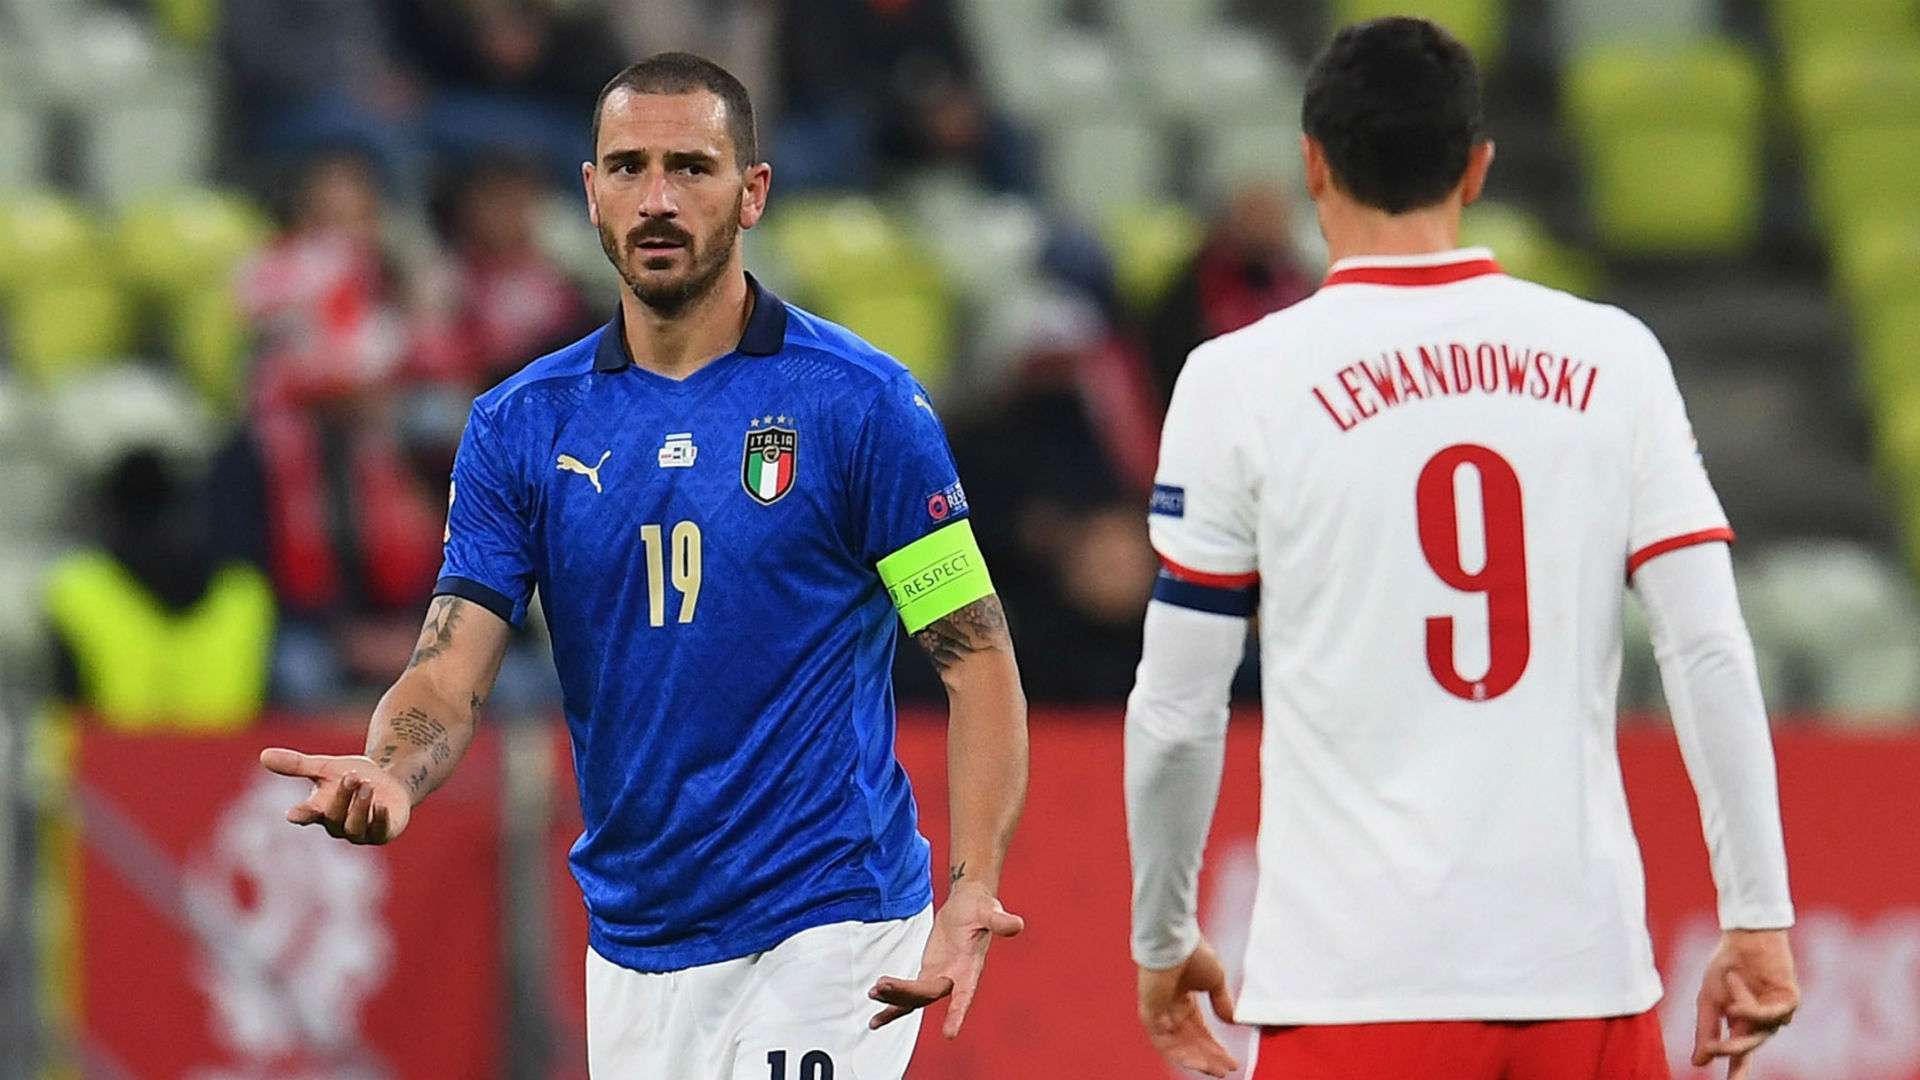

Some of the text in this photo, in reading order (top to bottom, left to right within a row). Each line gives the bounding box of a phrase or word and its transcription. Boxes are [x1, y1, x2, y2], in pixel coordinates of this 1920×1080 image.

[1312, 342, 1598, 432] LEWANDOWSKI
[750, 433, 793, 446] ITALIA
[640, 520, 702, 628] 19
[903, 554, 970, 598] RESPECT
[1416, 443, 1530, 702] 9
